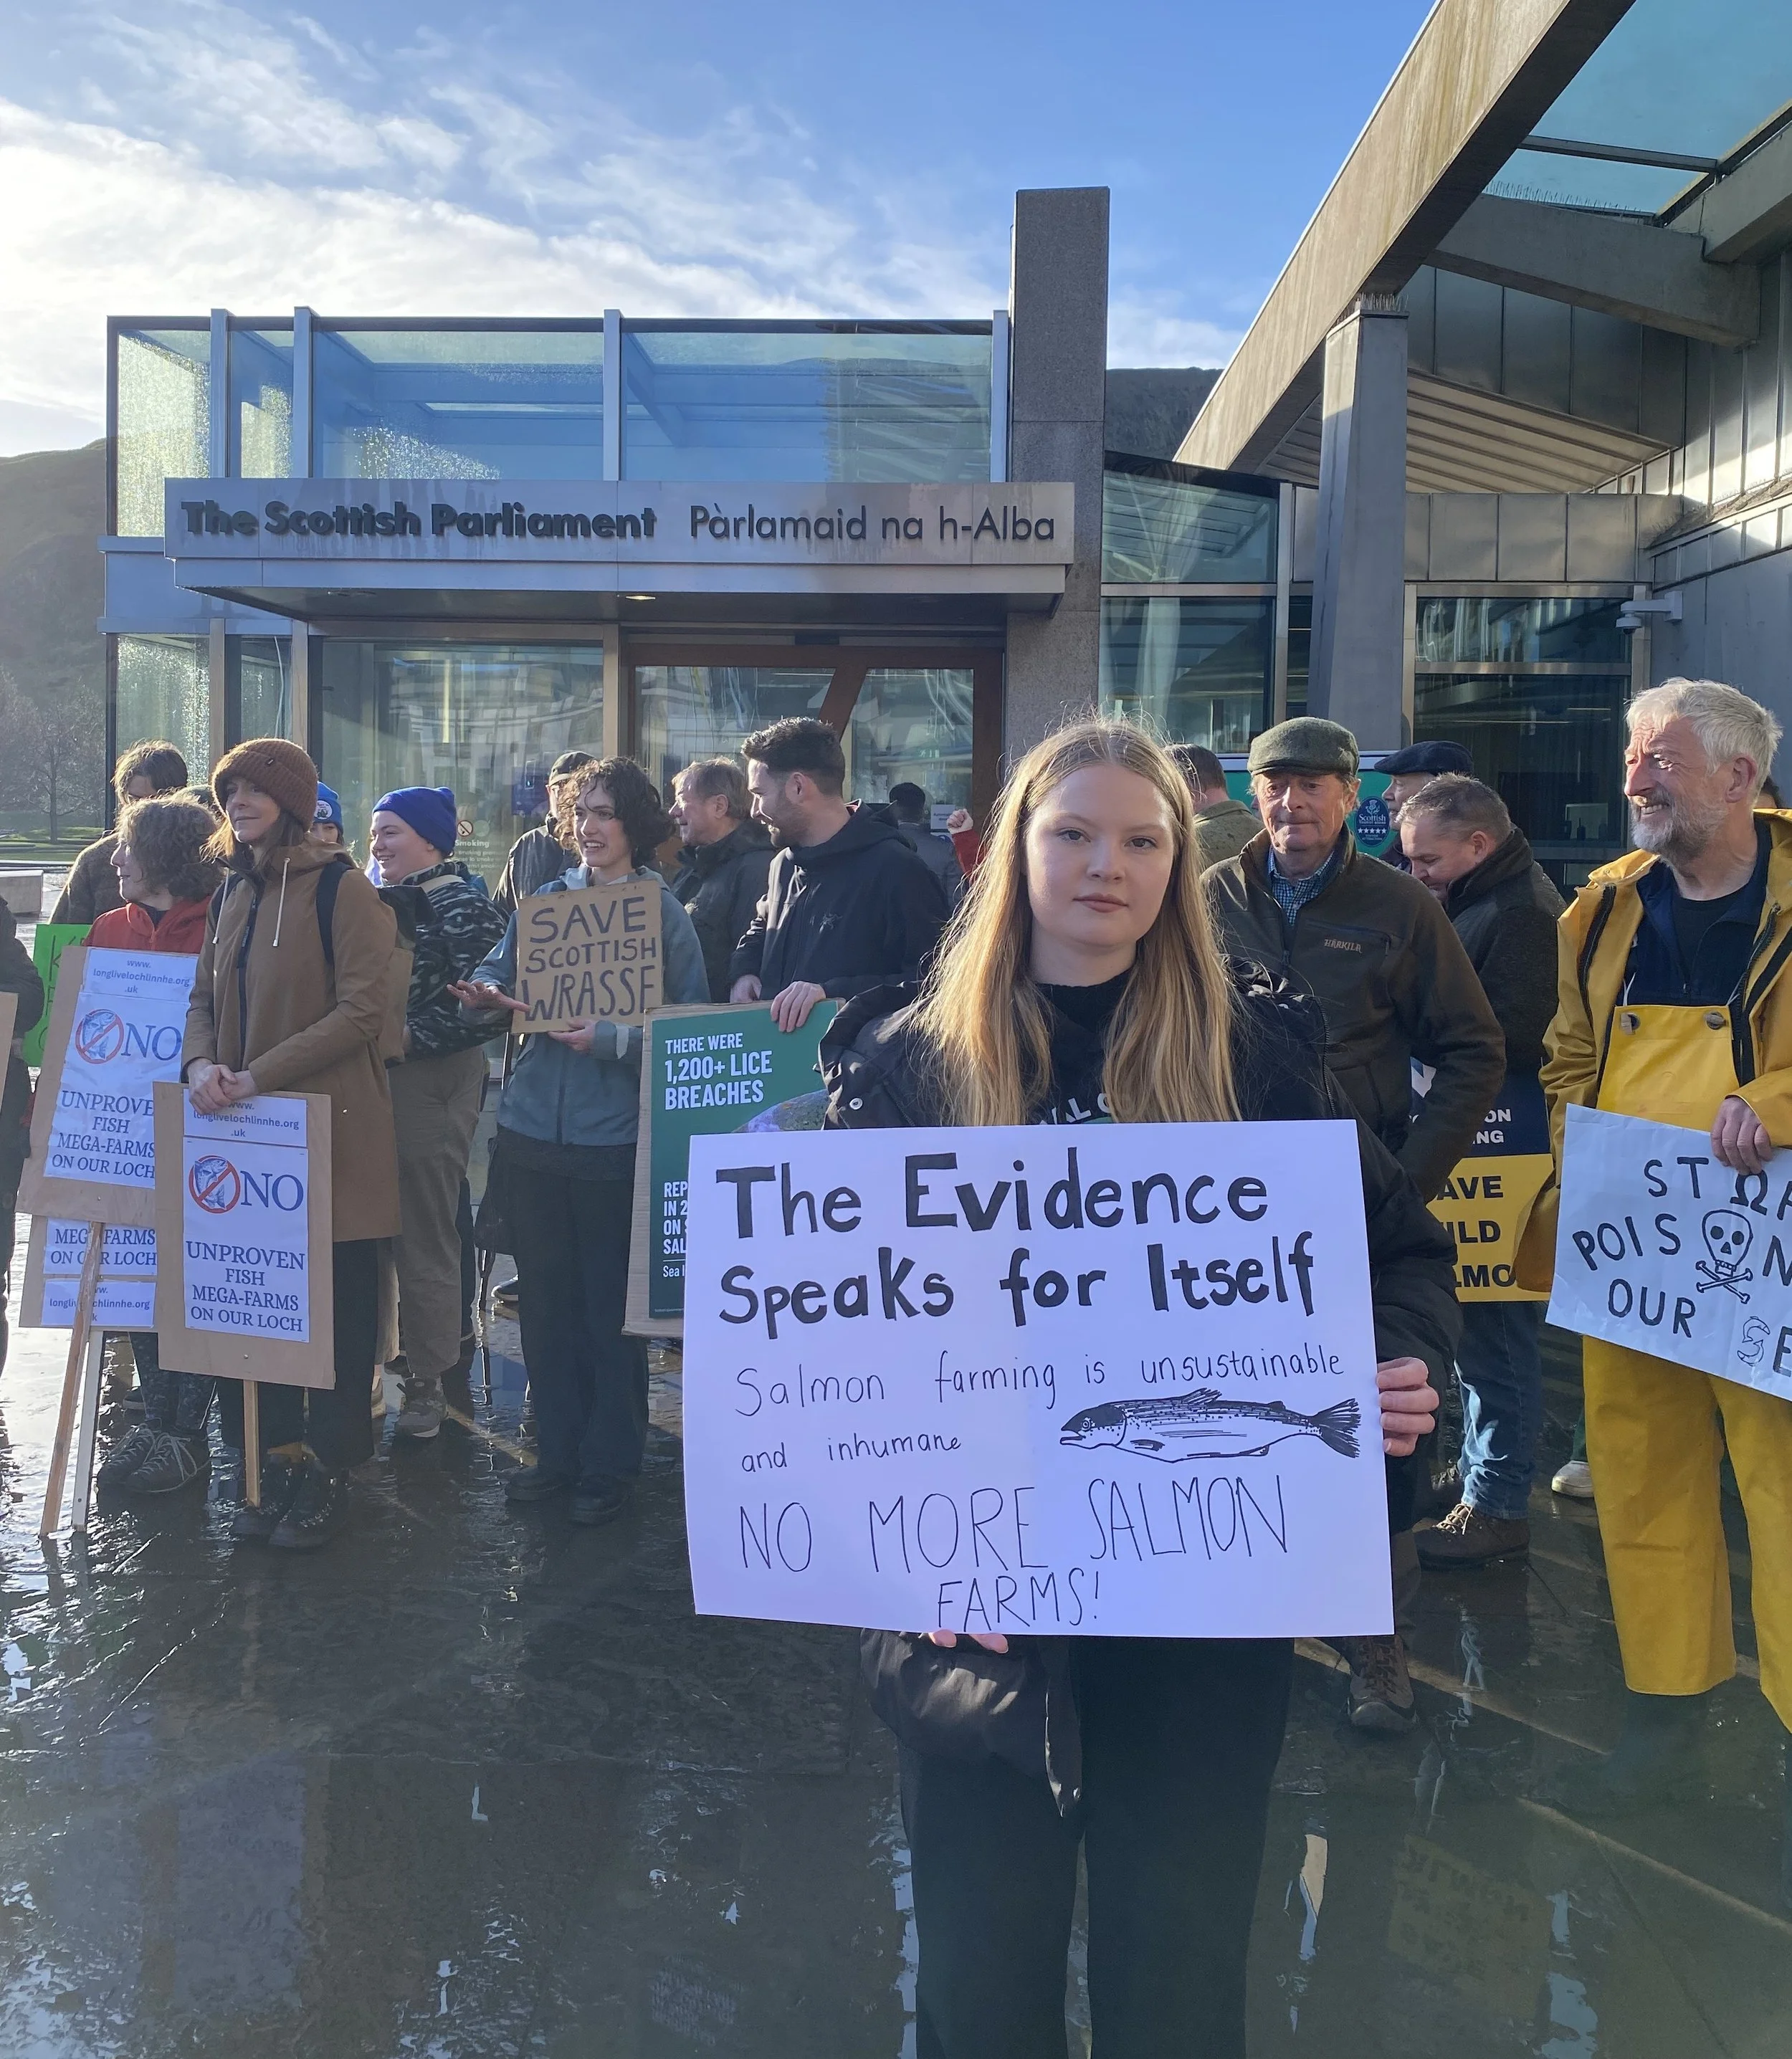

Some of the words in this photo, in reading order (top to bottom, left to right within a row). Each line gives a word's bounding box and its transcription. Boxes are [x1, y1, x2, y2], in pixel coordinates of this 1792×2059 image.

[181, 500, 257, 534] The
[264, 501, 421, 535] Scottish
[432, 502, 656, 537] Parliament
[690, 503, 866, 539] Pàrlamaid
[881, 516, 923, 539] na
[940, 505, 1054, 540] h-Alba
[454, 839, 490, 848] Smoking
[529, 897, 645, 944] SAVE
[127, 960, 151, 968] www.
[525, 937, 656, 973] SCOTTISH
[93, 968, 190, 987] longlivelochlinnhe.org
[120, 1023, 182, 1061] NO
[665, 1036, 704, 1054] THERE
[707, 1032, 743, 1050] WERE
[664, 1056, 725, 1084] 1,200+
[730, 1051, 772, 1076] LICE
[664, 1079, 764, 1110] BREACHES
[92, 1117, 130, 1134] FISH
[1473, 1130, 1505, 1145] NG
[57, 1132, 154, 1158] MEGA-FARMS
[52, 1154, 75, 1168] ON
[77, 1157, 110, 1173] OUR
[113, 1162, 154, 1178] LOCH
[240, 1170, 304, 1210] NO
[716, 1162, 862, 1238] The
[905, 1147, 1268, 1232] Evidence
[664, 1200, 677, 1216] IN
[54, 1228, 156, 1246] MEGFARMS
[663, 1219, 680, 1236] ON
[51, 1251, 73, 1264] ON
[114, 1252, 157, 1266] LOCH
[186, 1241, 305, 1271] UNPROVEN
[226, 1268, 265, 1286] FISH
[662, 1265, 680, 1278] Sea
[719, 1247, 954, 1339] Speaks
[999, 1248, 1107, 1327] for
[1146, 1231, 1315, 1317] Itself
[192, 1285, 299, 1311] MEGA-FARMS
[1608, 1279, 1696, 1338] OUR
[191, 1306, 214, 1321] ON
[218, 1309, 254, 1326] OUR
[257, 1314, 303, 1332] LOCH
[735, 1364, 884, 1416] Salmon
[935, 1350, 1056, 1409] farming
[1085, 1354, 1105, 1384] is
[1142, 1342, 1345, 1383] unsustainable
[741, 1442, 787, 1472] and
[828, 1433, 962, 1461] inhumane
[740, 1502, 811, 1572] NO
[869, 1487, 1049, 1574] MORE
[1088, 1474, 1287, 1561] SALMON
[937, 1567, 1100, 1632] FARMS!
